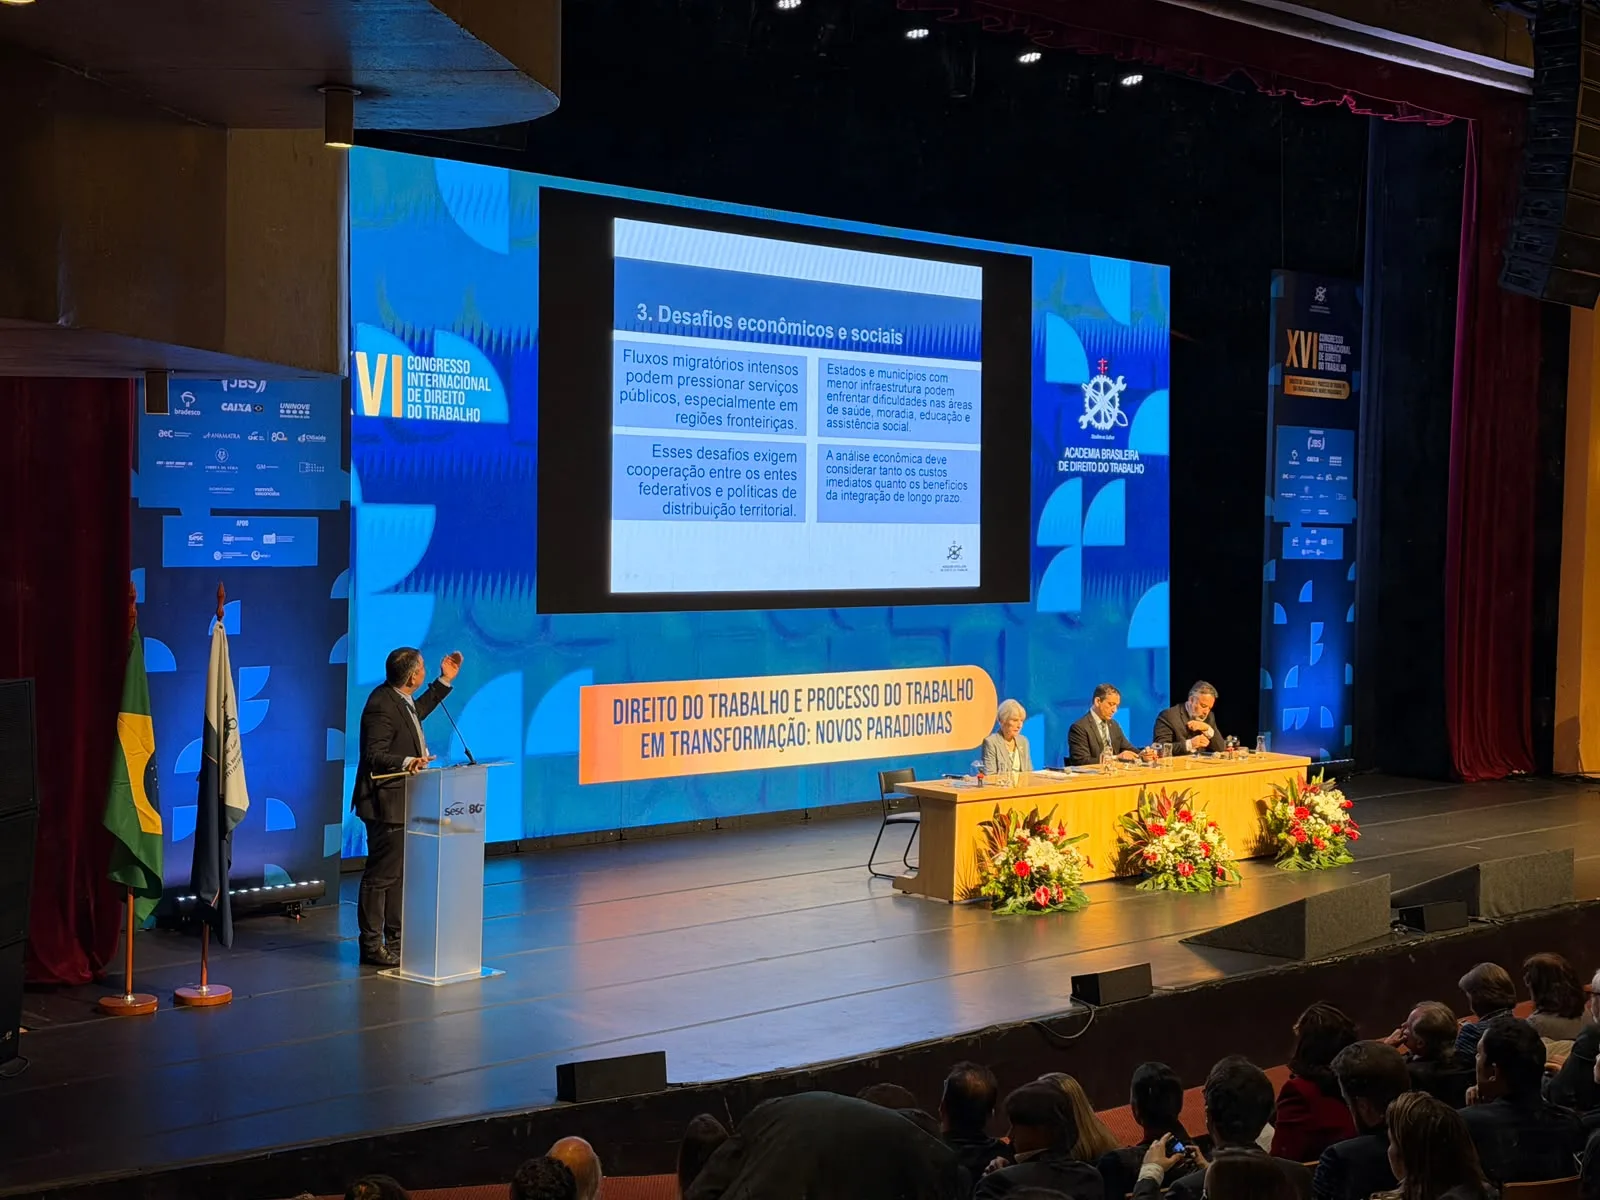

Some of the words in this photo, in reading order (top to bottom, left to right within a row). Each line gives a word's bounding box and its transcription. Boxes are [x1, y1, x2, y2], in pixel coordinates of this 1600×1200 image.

[637, 303, 652, 321] 3.
[658, 305, 733, 328] Desafios
[737, 317, 834, 338] econômicos
[838, 327, 847, 340] e
[851, 328, 904, 345] sociais
[1286, 328, 1318, 370] XVI
[408, 356, 470, 374] CONGRESSO
[623, 349, 668, 365] Fluxos
[672, 354, 744, 372] migratórios
[748, 360, 798, 376] intensos
[408, 373, 491, 392] INTERNACIONAL
[626, 370, 673, 386] podem
[677, 376, 745, 390] pressionar
[748, 380, 798, 396] serviços
[827, 363, 866, 377] Estados
[869, 369, 875, 378] e
[878, 368, 926, 385] municípios
[929, 373, 948, 383] com
[350, 351, 402, 418] VI
[827, 380, 858, 390] menor
[860, 380, 922, 394] infraestrutura
[924, 386, 954, 397] podem
[408, 388, 422, 403] DE
[424, 390, 465, 405] DIREITO
[620, 388, 680, 406] públicos,
[684, 393, 775, 411] especialmente
[780, 401, 798, 412] em
[827, 391, 870, 404] enfrentar
[872, 394, 927, 408] dificuldades
[930, 398, 946, 408] nas
[948, 398, 972, 410] áreas
[174, 408, 200, 416] bradesco
[221, 403, 251, 412] CAIXA
[280, 402, 310, 410] UNINOVE
[408, 404, 422, 419] DO
[426, 405, 480, 423] TRABALHO
[827, 404, 838, 415] de
[842, 405, 874, 418] saúde,
[877, 409, 916, 421] moradia,
[920, 410, 962, 424] educação
[964, 413, 970, 422] e
[676, 412, 722, 428] regiões
[726, 414, 798, 432] fronteiriças.
[826, 418, 880, 431] assistência
[882, 421, 912, 432] social.
[652, 444, 692, 458] Esses
[696, 446, 750, 461] desafios
[753, 450, 798, 465] exigem
[826, 450, 834, 460] A
[836, 450, 870, 462] análise
[873, 452, 922, 464] econômica
[926, 454, 947, 465] deve
[1064, 446, 1100, 458] ACADEMIA
[1102, 448, 1139, 460] BRASILEIRA
[626, 464, 706, 481] cooperação
[709, 468, 742, 480] entre
[746, 469, 760, 480] os
[764, 469, 798, 480] entes
[826, 464, 877, 476] considerar
[879, 466, 902, 476] tanto
[905, 468, 916, 476] os
[918, 468, 948, 478] custos
[1058, 460, 1068, 472] DE
[1070, 461, 1096, 472] DIREITO
[1098, 462, 1110, 473] DO
[1110, 462, 1144, 474] TRABALHO
[638, 482, 712, 496] federativos
[716, 486, 723, 497] e
[727, 484, 778, 500] políticas
[782, 486, 797, 498] de
[826, 476, 872, 488] imediatos
[874, 478, 906, 490] quanto
[909, 480, 920, 489] os
[826, 490, 838, 500] da
[841, 490, 891, 504] integração
[894, 492, 904, 502] de
[908, 492, 932, 504] longo
[662, 502, 736, 519] distribuição
[740, 504, 797, 517] territorial.
[613, 696, 677, 725] DIREITO
[682, 694, 704, 720] DO
[708, 689, 789, 718] TRABALHO
[794, 689, 802, 712] E
[807, 684, 880, 712] PROCESSO
[884, 682, 901, 707] DO
[906, 678, 974, 705] TRABALHO
[640, 732, 664, 759] EM
[670, 717, 811, 757] TRANSFORMAÇÃO:
[816, 718, 862, 744] NOVOS
[867, 710, 952, 740] PARADIGMAS
